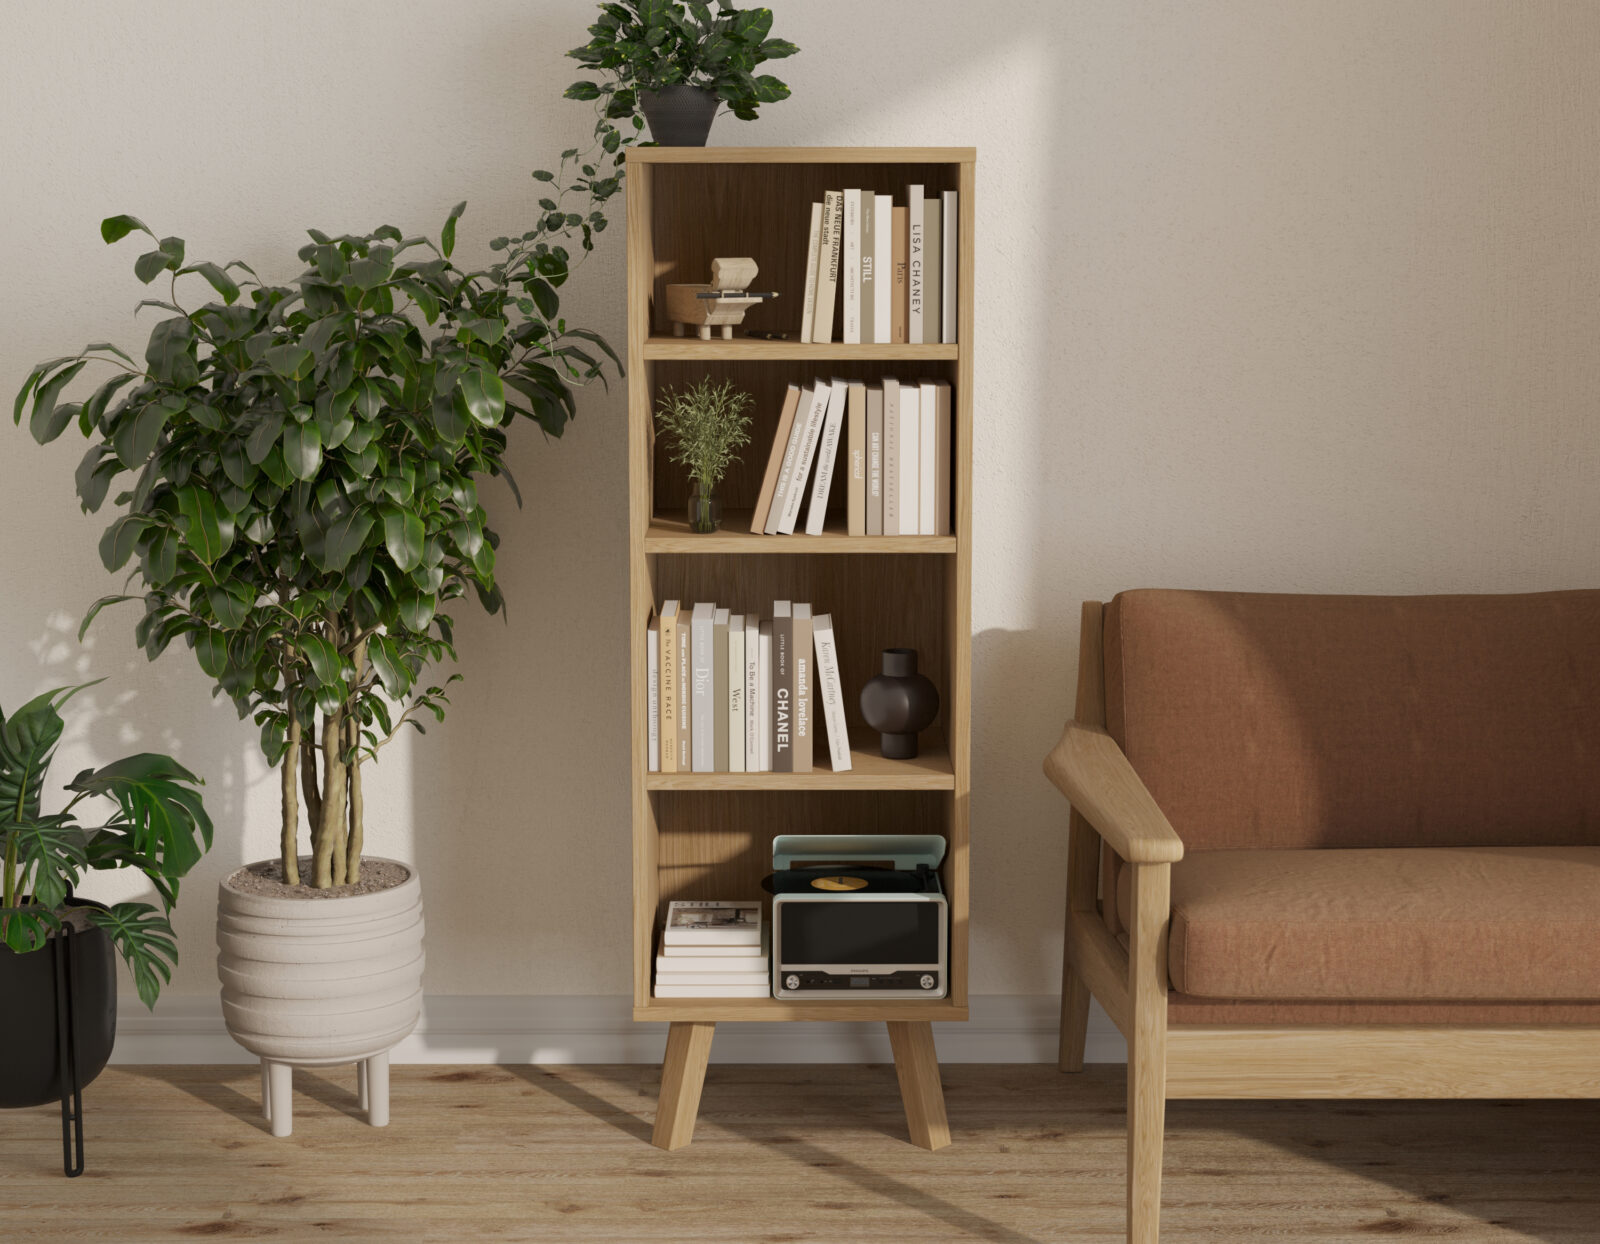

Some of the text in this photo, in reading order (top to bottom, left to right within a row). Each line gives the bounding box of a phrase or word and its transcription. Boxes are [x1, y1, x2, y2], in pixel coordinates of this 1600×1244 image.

[835, 196, 843, 212] DAS
[830, 237, 839, 282] FRANKFURT
[863, 257, 872, 283] STILL
[897, 263, 906, 284] Paris
[801, 428, 815, 465] sustainable
[811, 402, 823, 428] lifestyle
[779, 481, 787, 497] THIS
[787, 445, 797, 467] GOOD
[792, 422, 802, 444] GUIDE
[818, 472, 827, 499] DREAM
[827, 423, 836, 449] AWAKE
[821, 641, 833, 664] Karen
[696, 668, 709, 696] Dior
[750, 671, 755, 680] Be
[823, 665, 838, 705] McCartney
[732, 689, 741, 712] West
[799, 659, 808, 736] amanda lovelace
[778, 688, 788, 752] CHANEL
